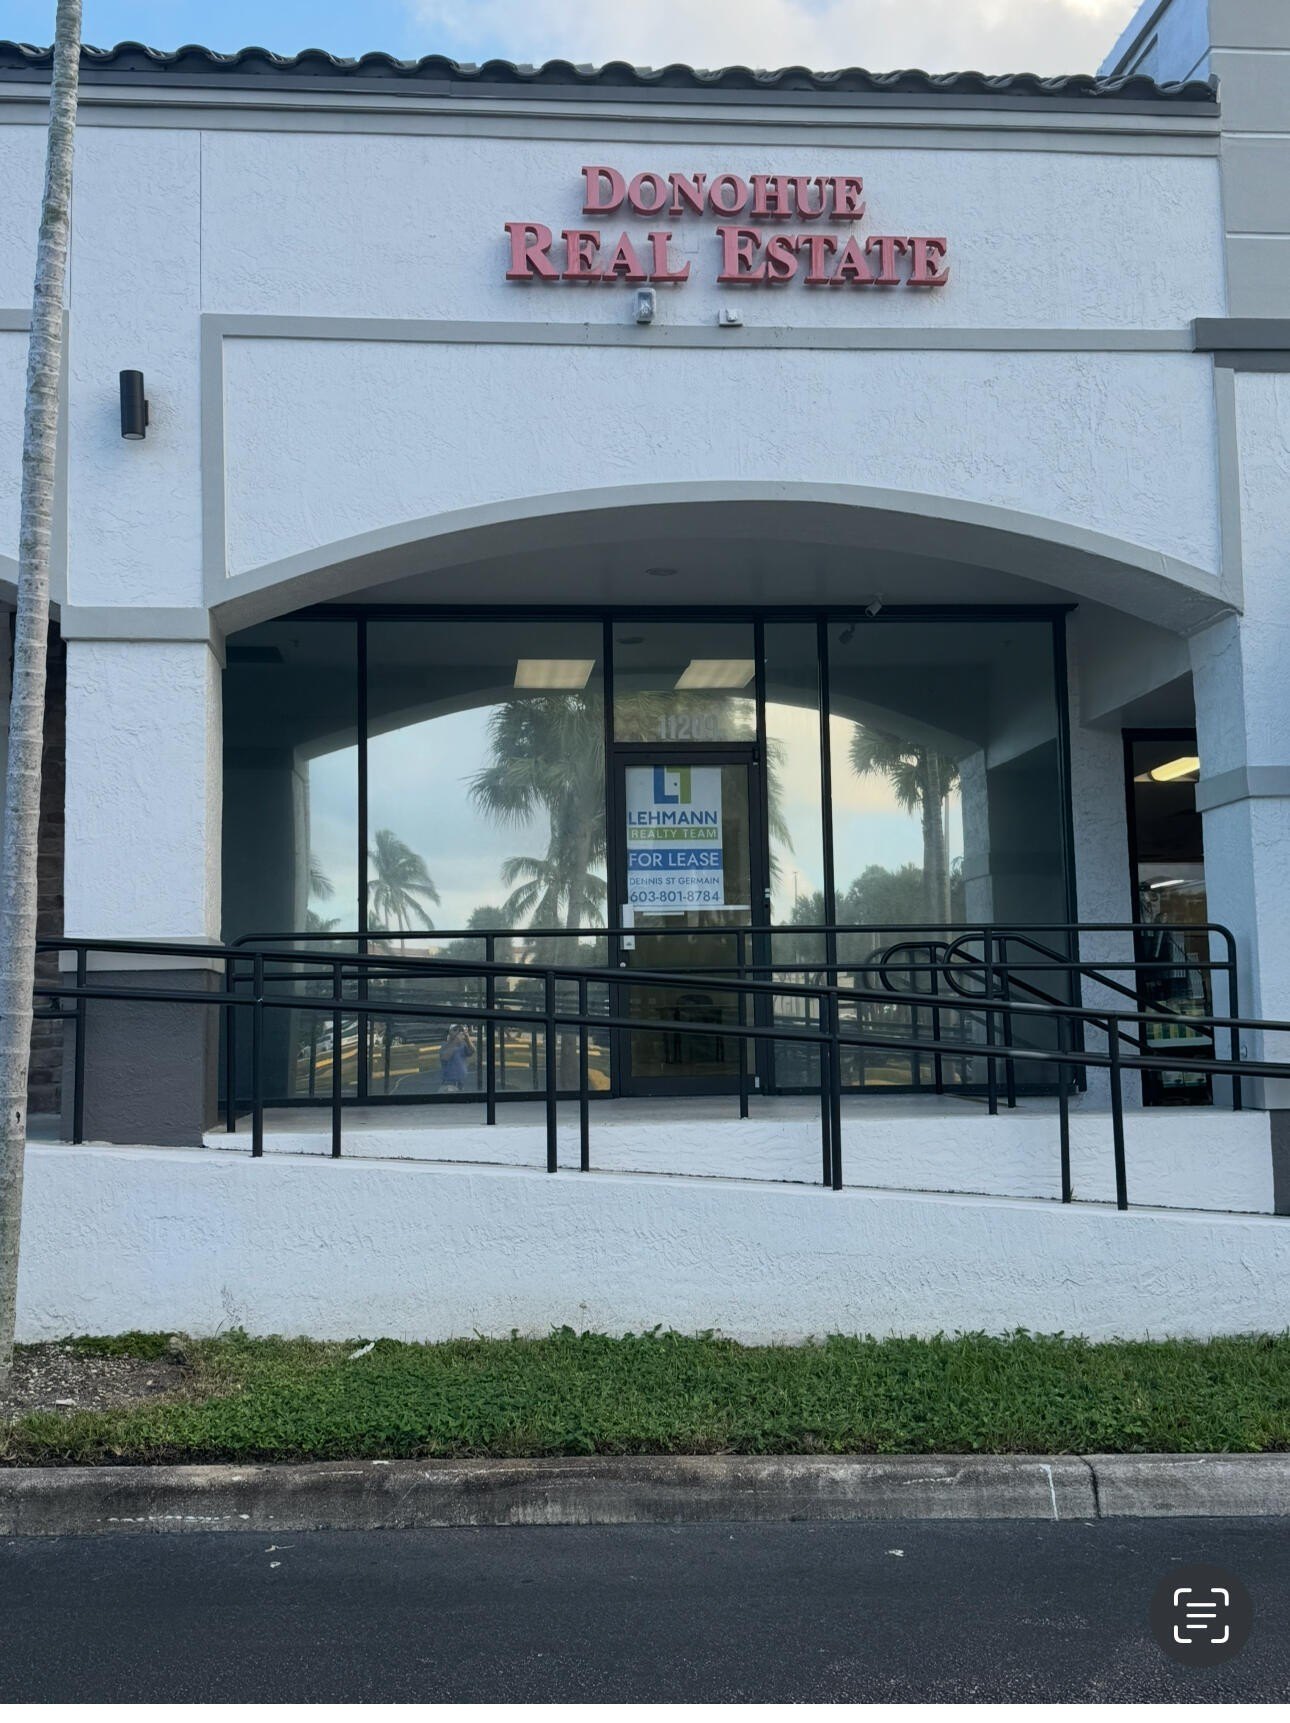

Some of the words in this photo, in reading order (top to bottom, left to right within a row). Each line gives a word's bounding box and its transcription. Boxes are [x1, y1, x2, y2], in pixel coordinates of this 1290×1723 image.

[581, 166, 867, 221] DONOHUE
[504, 222, 691, 282] REAL
[716, 225, 950, 287] ESTATE
[628, 811, 718, 825] LEHMANN
[631, 829, 677, 839] REALTY
[683, 828, 717, 838] TEAM
[629, 853, 662, 867] FOR
[668, 852, 719, 867] LEASE
[629, 877, 663, 885] DENNIS
[665, 877, 675, 885] ST
[678, 877, 720, 885] GERMAIN
[630, 891, 720, 903] 603-801-8784
